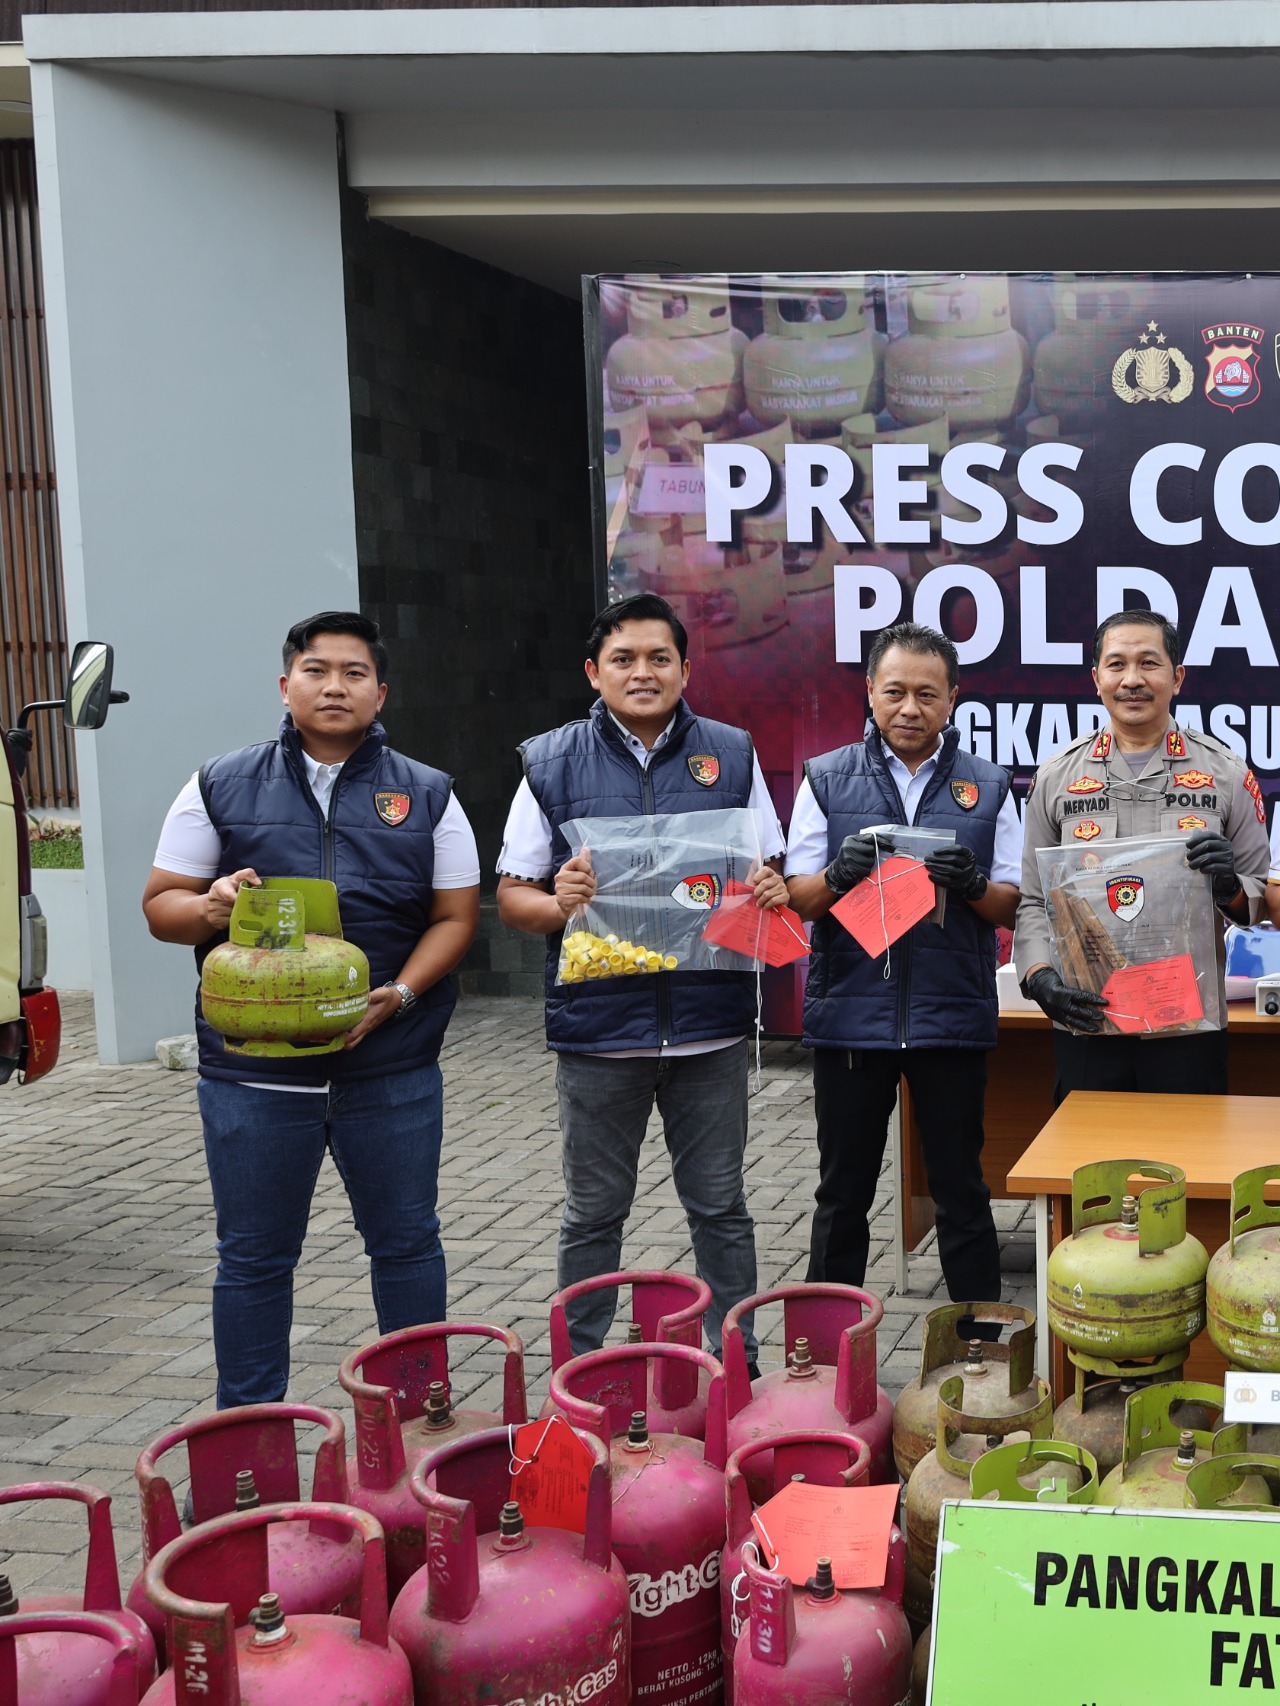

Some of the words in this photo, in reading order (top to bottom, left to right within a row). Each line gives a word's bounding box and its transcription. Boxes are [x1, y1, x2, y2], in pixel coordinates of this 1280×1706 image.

[1208, 326, 1259, 340] BANTEN
[659, 479, 705, 494] TABUN
[703, 442, 1084, 546] PRESS
[834, 564, 1280, 667] POLDA
[947, 701, 1111, 766] GKAP
[1063, 797, 1110, 816] MERYADI
[1165, 793, 1217, 810] POLRI
[630, 1563, 701, 1618] ight
[657, 1662, 689, 1681] NETTO
[698, 1649, 717, 1666] 12kg
[573, 1659, 618, 1704] Gas
[637, 1681, 666, 1696] BERAT
[668, 1668, 704, 1688] KOSONG:
